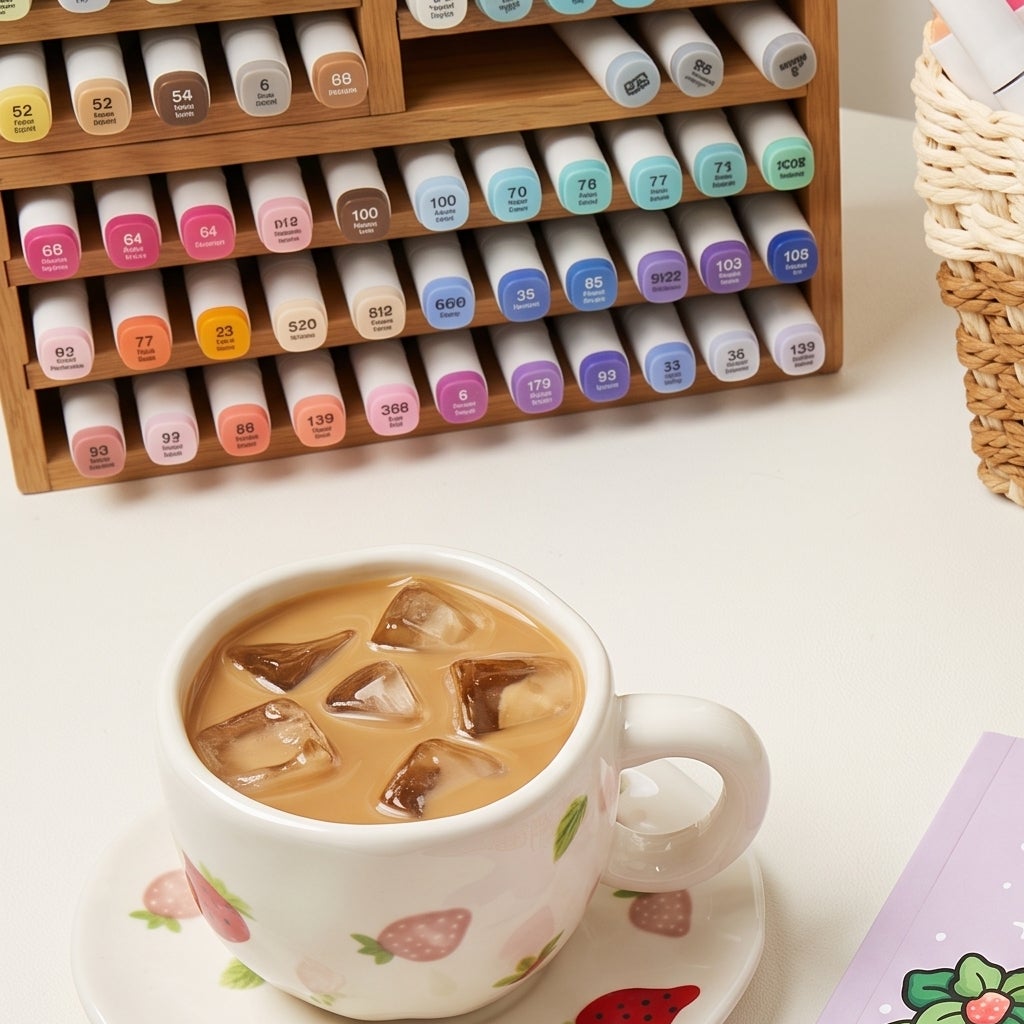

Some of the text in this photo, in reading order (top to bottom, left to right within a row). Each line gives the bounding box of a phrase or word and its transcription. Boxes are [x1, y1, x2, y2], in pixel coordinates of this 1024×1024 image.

[259, 78, 270, 91] 6
[172, 90, 193, 103] 54
[92, 97, 113, 110] 52
[12, 105, 33, 118] 52
[649, 175, 667, 187] 77
[507, 186, 527, 199] 70
[430, 194, 456, 209] 100
[351, 207, 378, 221] 100
[199, 226, 218, 239] 64
[123, 233, 142, 246] 64
[715, 258, 742, 272] 103
[585, 276, 603, 289] 85
[215, 325, 234, 338] 23
[288, 318, 317, 332] S20
[135, 336, 154, 347] 77
[789, 342, 816, 355] 139
[663, 360, 681, 372] 33
[598, 370, 616, 382] 93
[527, 378, 551, 391] 179
[459, 389, 468, 401] 6
[307, 413, 334, 426] 139
[89, 445, 108, 457] 93
